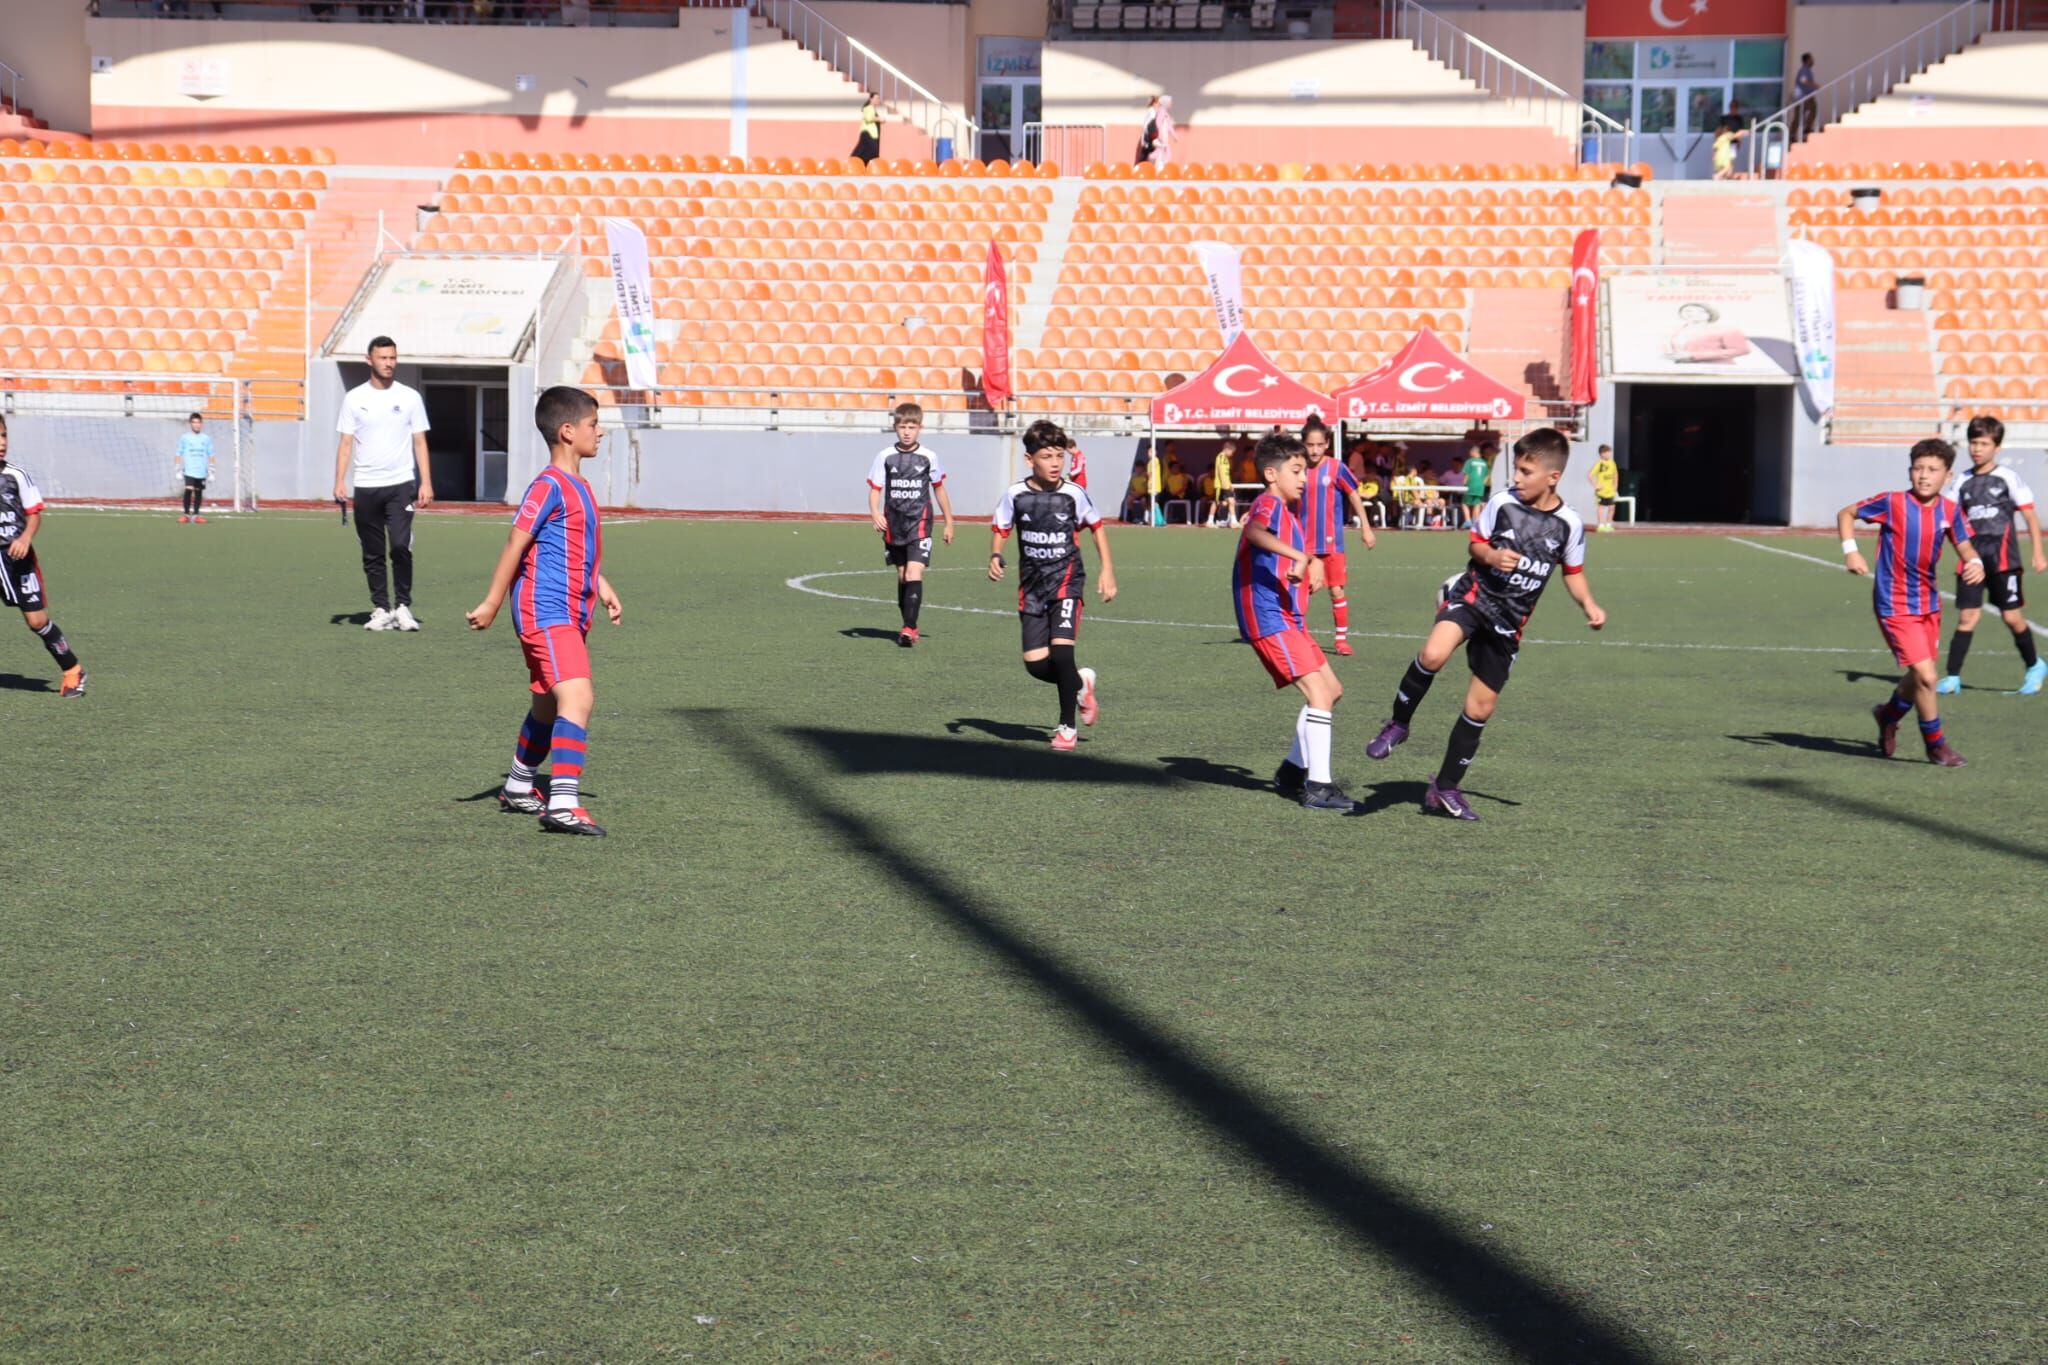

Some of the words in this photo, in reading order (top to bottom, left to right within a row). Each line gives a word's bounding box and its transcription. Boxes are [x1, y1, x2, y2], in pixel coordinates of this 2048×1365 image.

[1184, 408, 1208, 419] T.C.
[1210, 407, 1241, 418] İZMİT
[1369, 402, 1393, 413] T.C.
[1396, 401, 1427, 412] İZMİT
[890, 490, 921, 499] GROUP
[1060, 598, 1074, 619] 9
